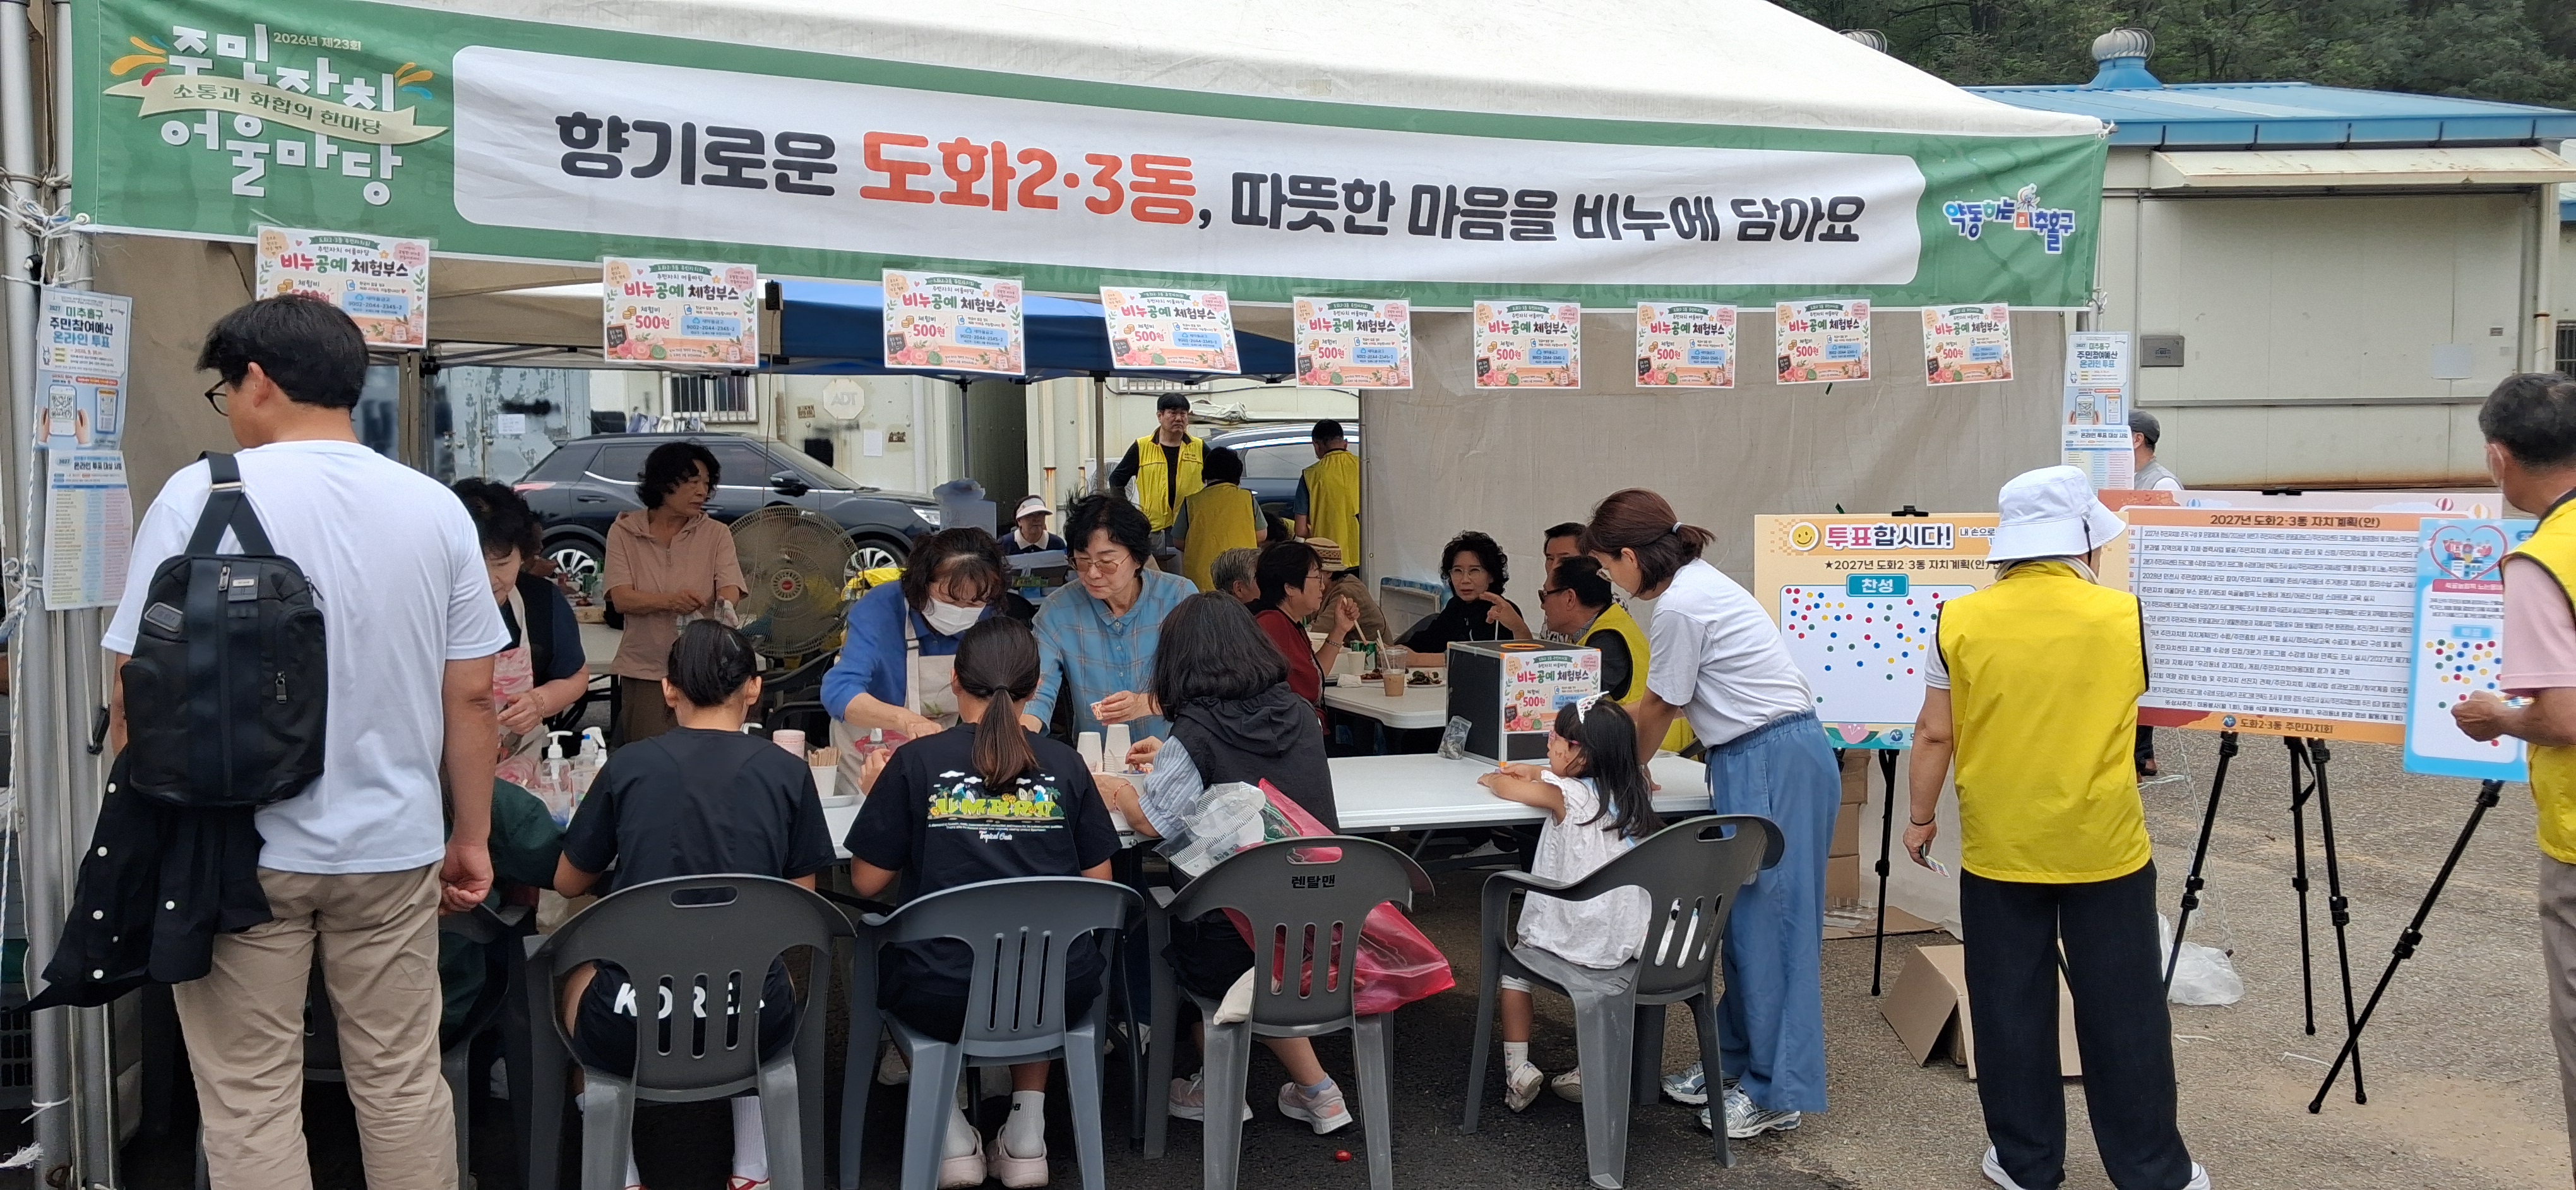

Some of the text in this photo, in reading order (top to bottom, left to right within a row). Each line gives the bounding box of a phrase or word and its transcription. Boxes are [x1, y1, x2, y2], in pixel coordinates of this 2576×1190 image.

[273, 32, 361, 51] 2026년 제23회
[169, 23, 395, 112] 주민자치
[174, 84, 382, 135] 소통과 화합의 한마당
[160, 111, 403, 206] 어울마당
[556, 111, 838, 195] 향기로운
[1231, 170, 1396, 236] 따뜻한
[1408, 183, 1559, 243] 마음을
[1572, 192, 1720, 243] 비누에
[1729, 195, 1866, 244] 담아요
[1945, 199, 2073, 251] 약동하는 미추홀구
[280, 253, 408, 277] 비누공예 체험부스
[298, 279, 319, 287] 체험비
[624, 282, 739, 301] 비누공예 체험부스
[902, 292, 1006, 313] 비누공예 체험부스
[1121, 305, 1216, 320] 비누공예 체험부스
[50, 316, 113, 335] 주민참여예산
[635, 315, 670, 328] 500원
[1309, 318, 1395, 333] 비누공예 체험부스
[1488, 320, 1568, 335] 비누공예 체험부스
[1650, 321, 1725, 335] 비누공예 체험부스
[1789, 318, 1859, 332] 비누공예 체험부스
[1935, 321, 2000, 335] 비누공예 체험부스
[913, 324, 945, 337] 500원
[1135, 331, 1164, 341] 500원
[53, 331, 110, 348] 온라인 투표
[1319, 347, 1344, 359] 500원
[1496, 349, 1521, 360] 500원
[1657, 349, 1681, 360] 500원
[1796, 346, 1819, 357] 500원
[1943, 348, 1963, 359] 500원
[2080, 360, 2101, 368] 온라인
[831, 392, 857, 406] ADT
[2210, 515, 2381, 528] 2027년 도화2·3동 자치계획(안)
[1827, 526, 1950, 546] 투표합시다!
[1960, 527, 1996, 536] 내 손으로
[1861, 579, 1893, 593] 찬성
[1517, 670, 1589, 683] 비누공예 체험부스
[1524, 697, 1545, 707] 500원
[2240, 718, 2333, 733] 도화2·3동 주민자치회
[1291, 875, 1335, 888] 렌탈맨
